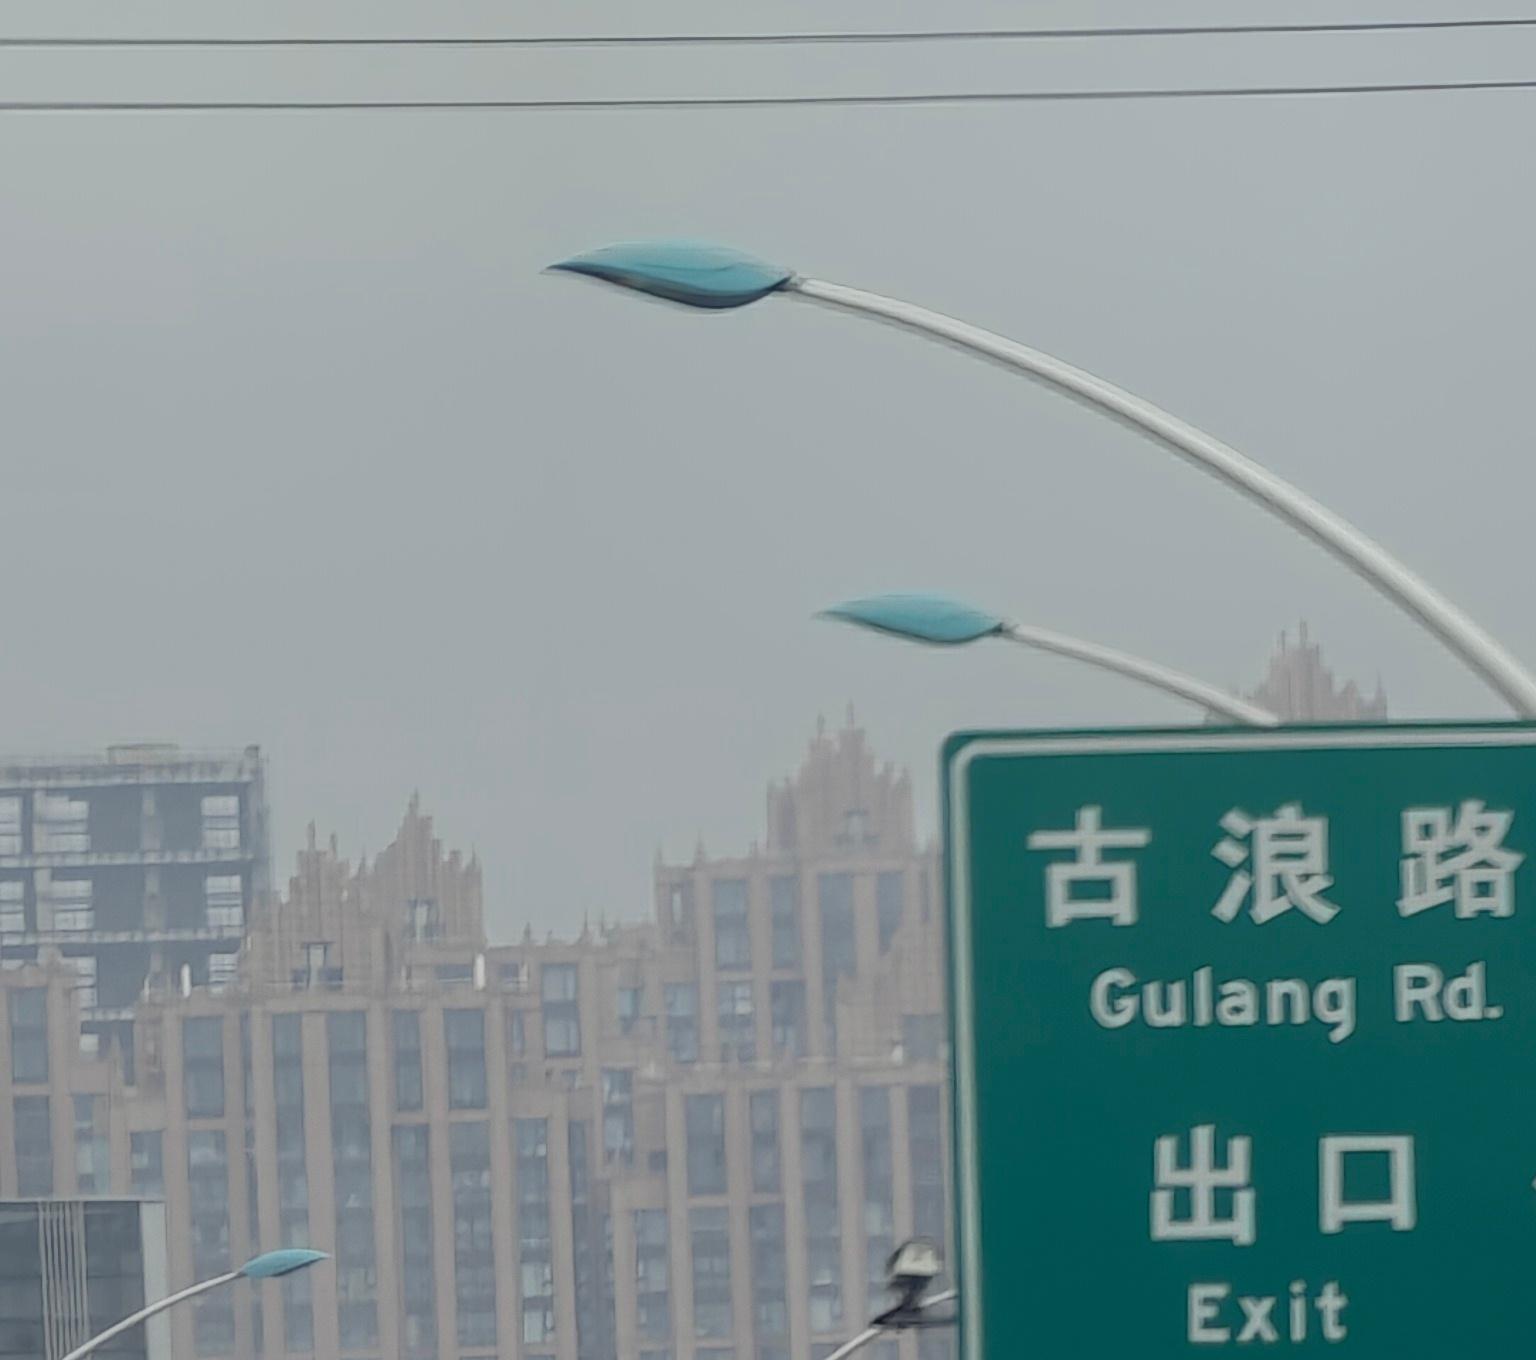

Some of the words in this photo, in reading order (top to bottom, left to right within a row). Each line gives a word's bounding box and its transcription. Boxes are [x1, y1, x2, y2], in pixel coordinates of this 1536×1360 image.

[1026, 800, 1525, 927] 古浪路
[1090, 966, 1357, 1043] Gulang
[1393, 960, 1505, 1023] Rd.
[1149, 1124, 1417, 1246] 出口
[1187, 1280, 1349, 1344] Exit
